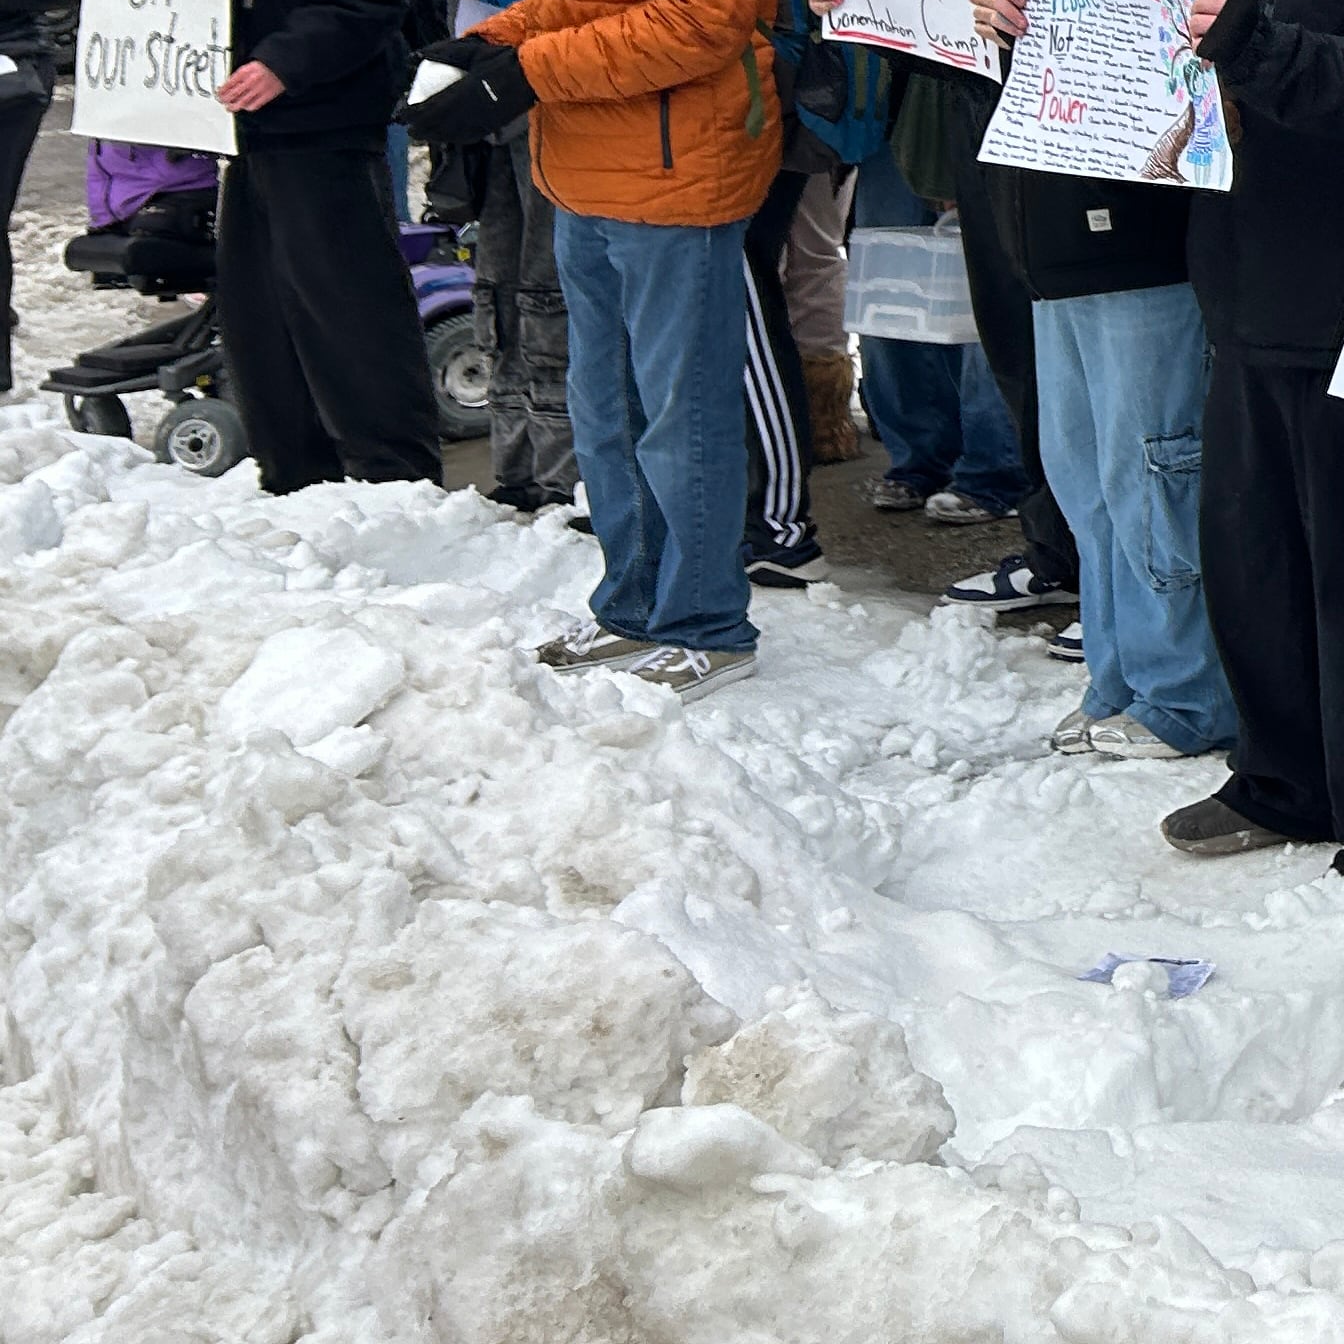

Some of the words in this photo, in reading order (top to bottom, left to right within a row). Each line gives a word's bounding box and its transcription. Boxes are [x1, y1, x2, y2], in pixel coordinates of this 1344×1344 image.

[84, 30, 136, 91] our
[1049, 23, 1075, 56] Not
[1036, 66, 1088, 125] Power
